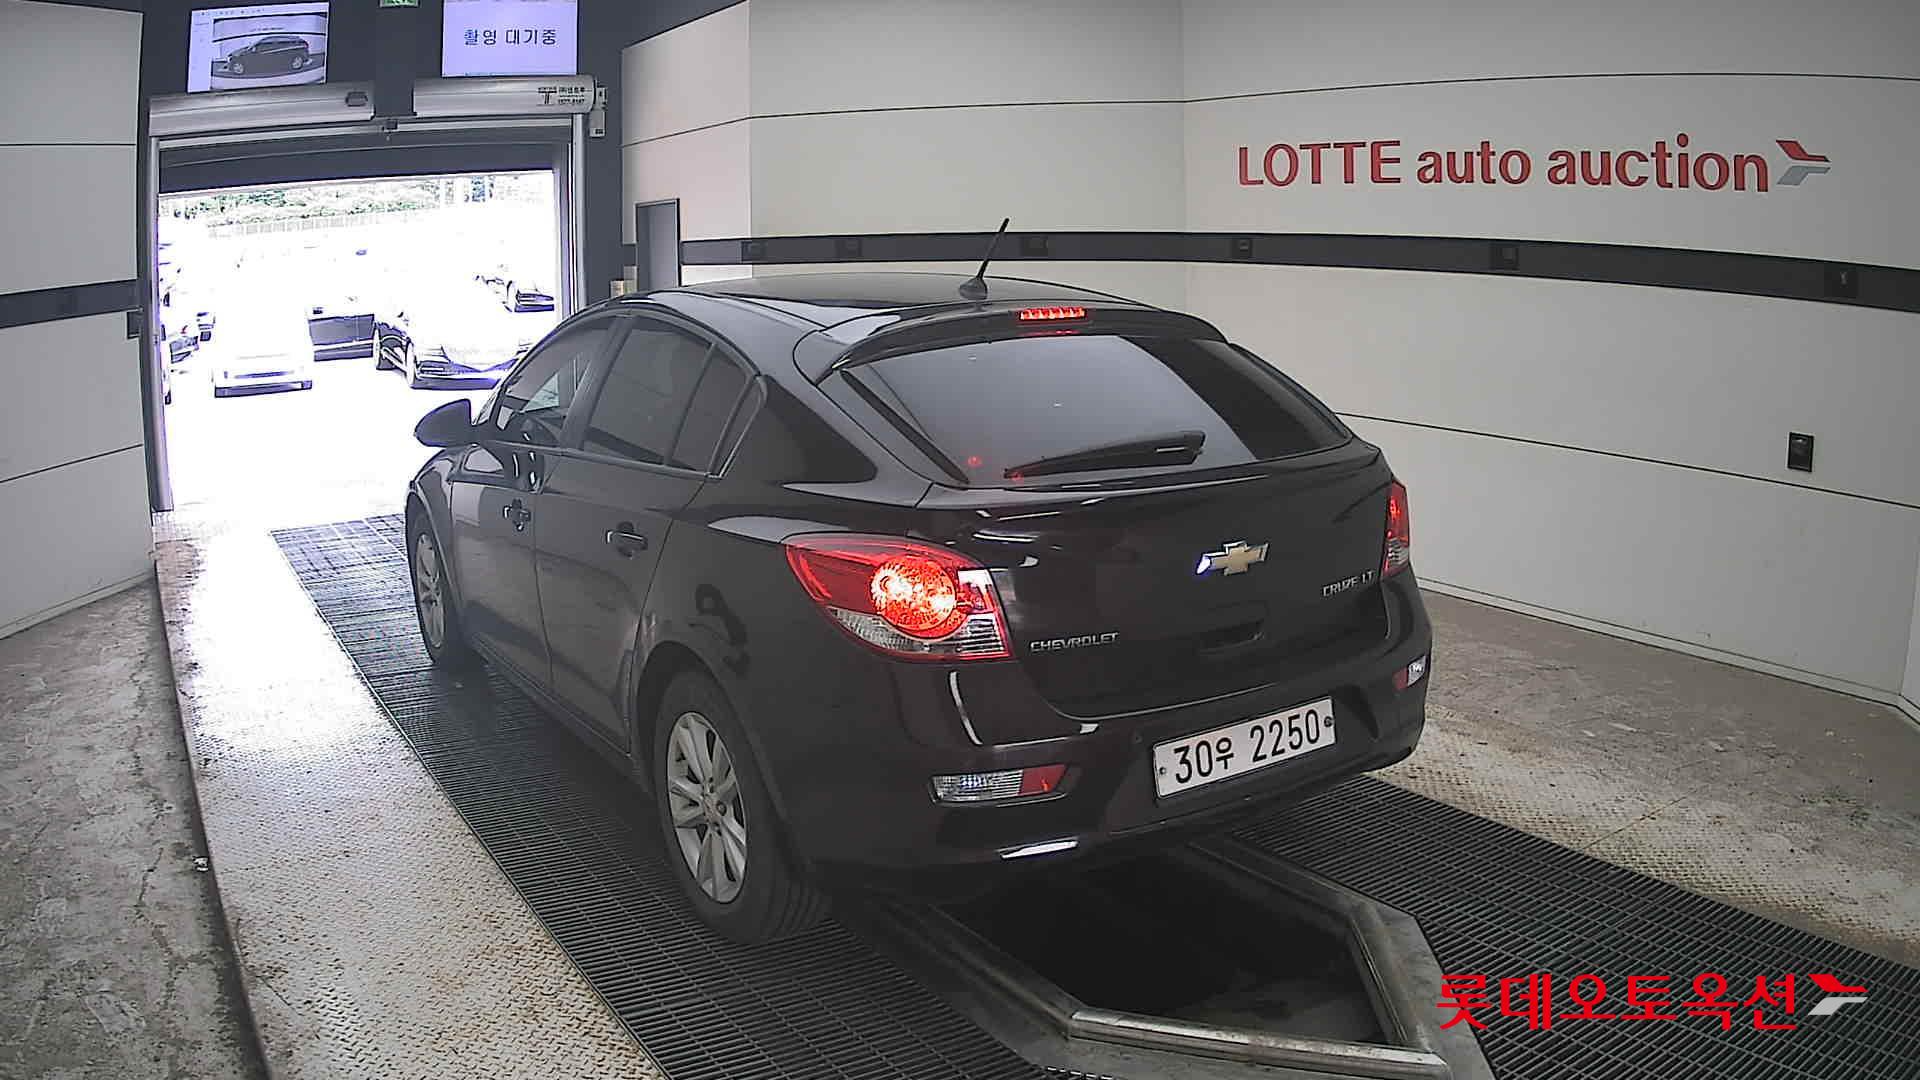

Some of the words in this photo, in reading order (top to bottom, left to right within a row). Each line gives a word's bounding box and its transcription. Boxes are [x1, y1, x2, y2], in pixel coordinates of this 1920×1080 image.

[463, 28, 497, 46] 촬영
[505, 28, 557, 46] 대기중
[1238, 140, 1401, 187] LOTTE
[1417, 140, 1532, 185] auto
[1547, 133, 1769, 192] auction
[1322, 577, 1359, 597] CRUZE
[1361, 570, 1374, 585] LT
[1030, 632, 1119, 652] CHEVROLET
[1173, 737, 1235, 784] 30우
[1249, 708, 1322, 764] 2250
